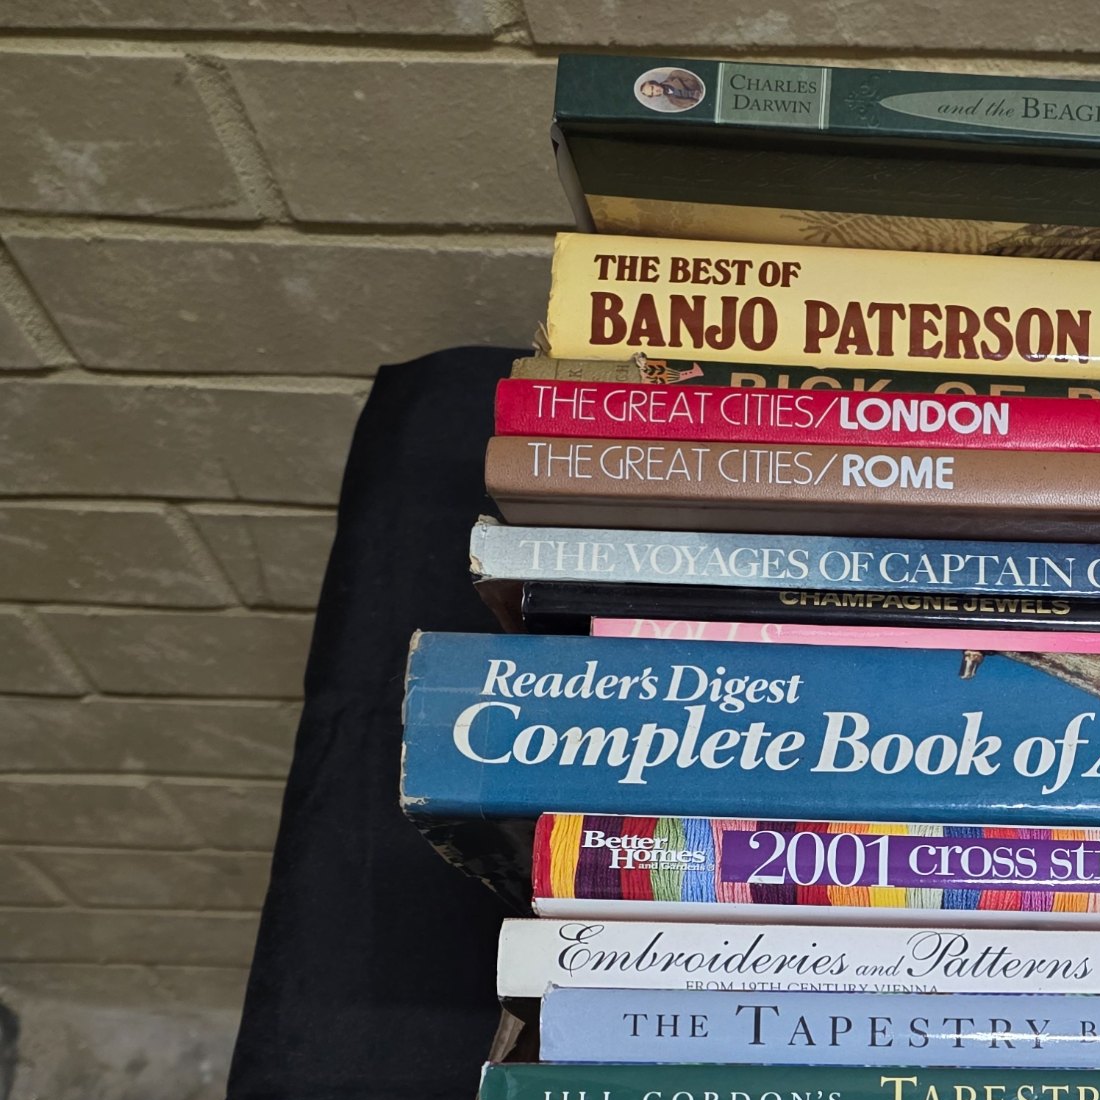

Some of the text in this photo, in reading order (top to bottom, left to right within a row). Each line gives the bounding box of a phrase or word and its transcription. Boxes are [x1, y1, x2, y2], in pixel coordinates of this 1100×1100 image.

[729, 73, 818, 95] CHARLES
[732, 93, 812, 115] DARWIN
[937, 101, 981, 117] and
[985, 97, 1016, 118] the
[594, 253, 802, 288] THE BEST OF
[588, 291, 1093, 365] BANJO PATERSON
[532, 385, 713, 425] THE GREAT
[527, 442, 711, 483] THE GREAT
[518, 540, 617, 575] THE
[623, 542, 810, 582] VOYAGES
[818, 550, 874, 584] OF
[878, 552, 1075, 588] CAPTAIN
[963, 596, 1072, 616] JEWELS
[663, 664, 804, 714] Digest
[452, 700, 806, 786] Complete
[810, 711, 1003, 777] Book
[1012, 711, 1097, 796] of
[581, 830, 668, 850] Better
[608, 848, 706, 869] Homes
[747, 829, 893, 888] 2001
[908, 843, 1038, 882] cross
[557, 922, 1094, 982] Embroideries and Patterns
[621, 1012, 710, 1039] THE
[735, 1004, 1053, 1051] TAPESTRY
